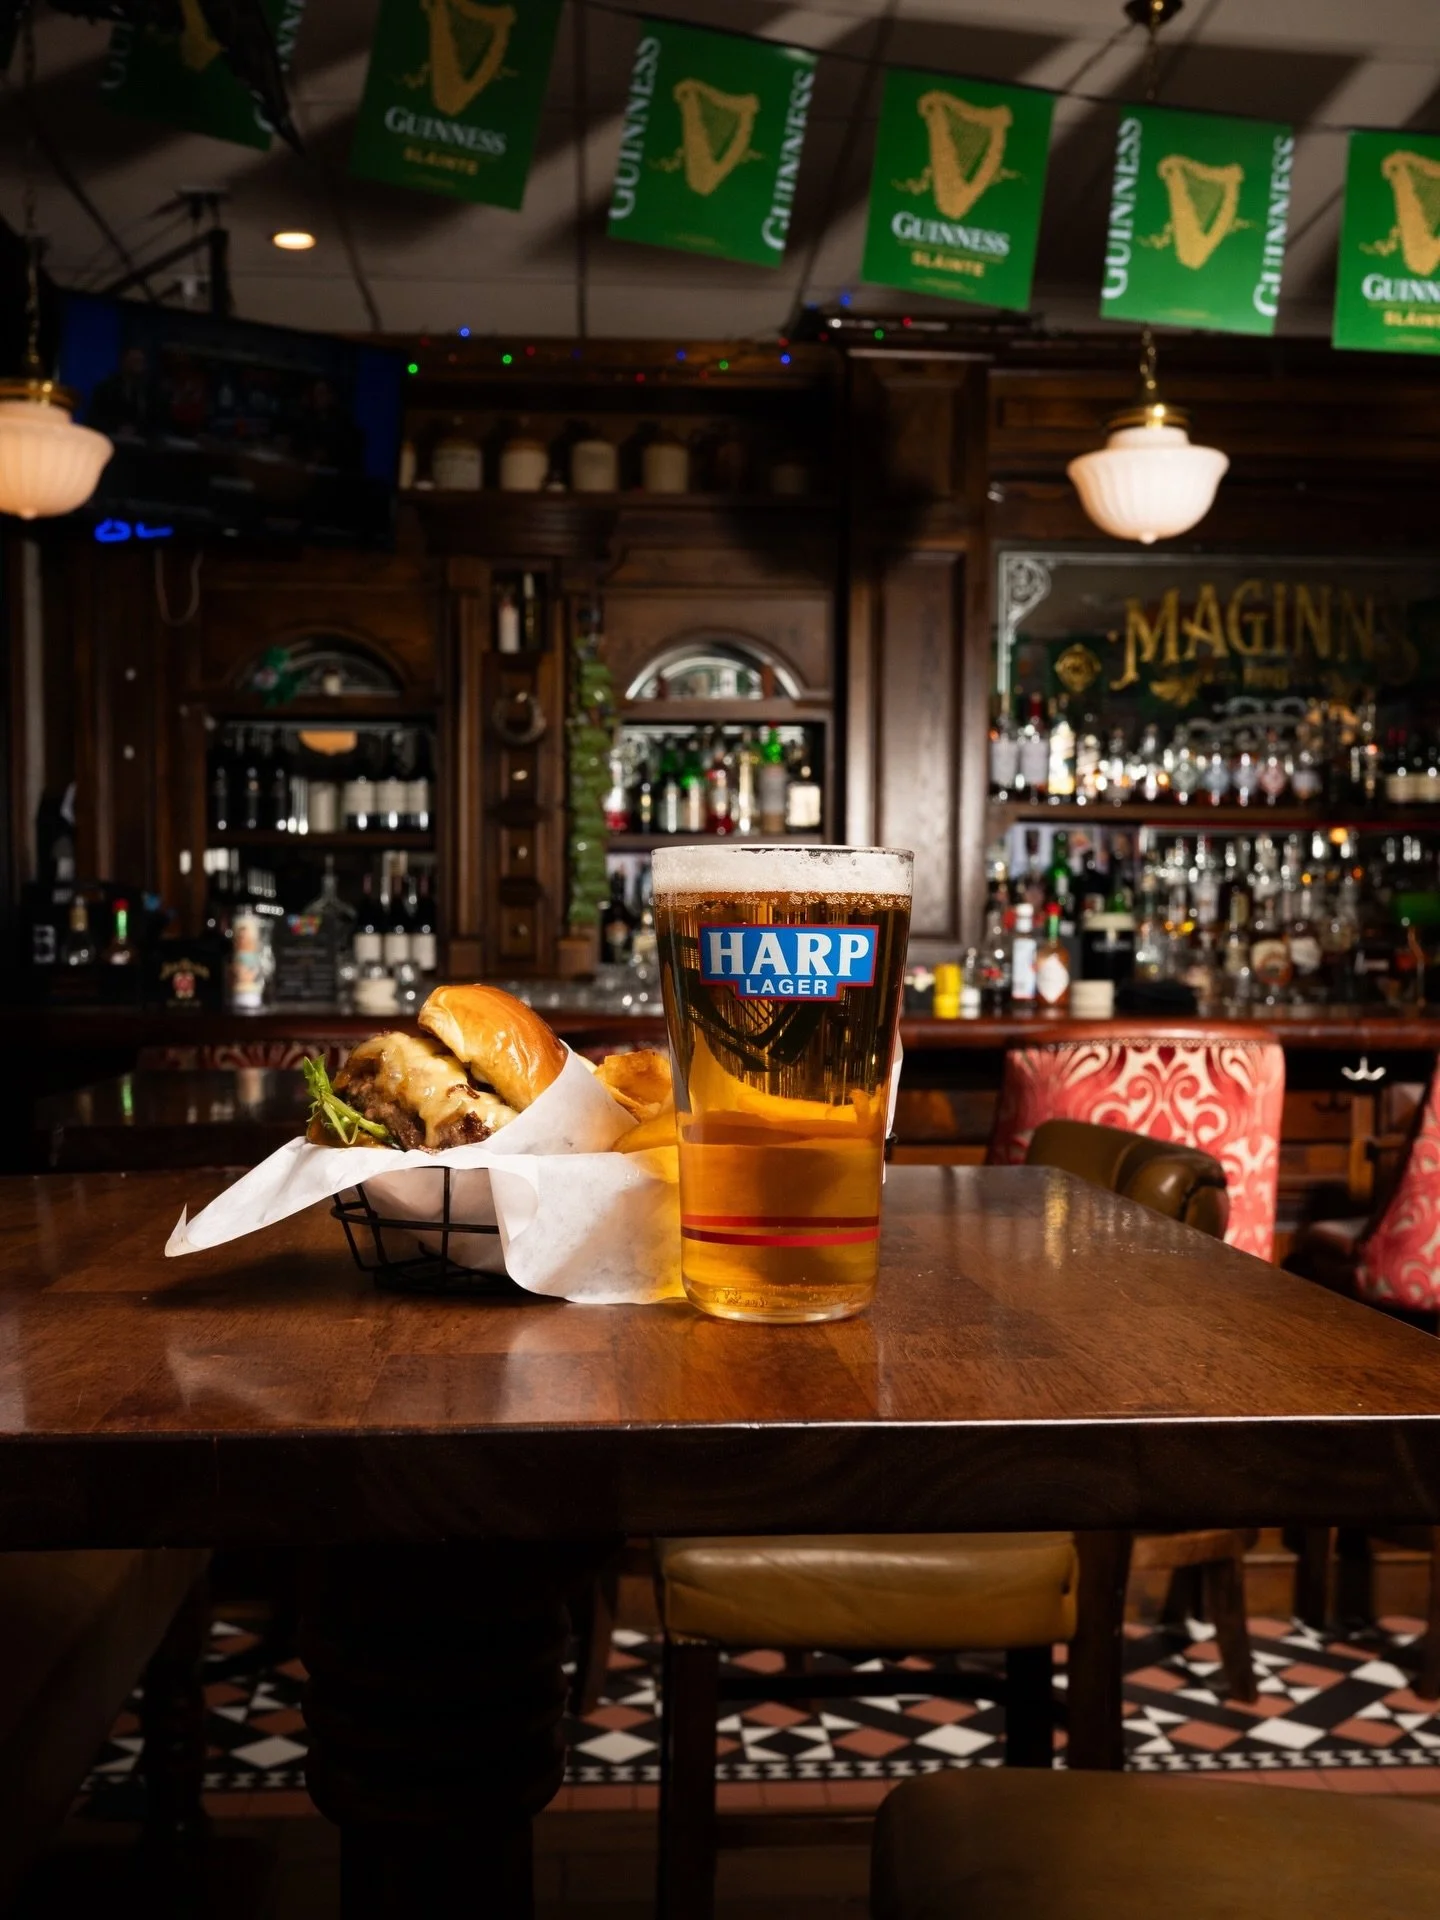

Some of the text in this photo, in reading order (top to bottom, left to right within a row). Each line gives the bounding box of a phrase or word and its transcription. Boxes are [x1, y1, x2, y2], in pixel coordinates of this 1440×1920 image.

[384, 106, 507, 155] GUINNESS
[891, 211, 1010, 256] GUINNESS
[707, 931, 870, 977] HARP
[745, 978, 828, 995] LAGER
